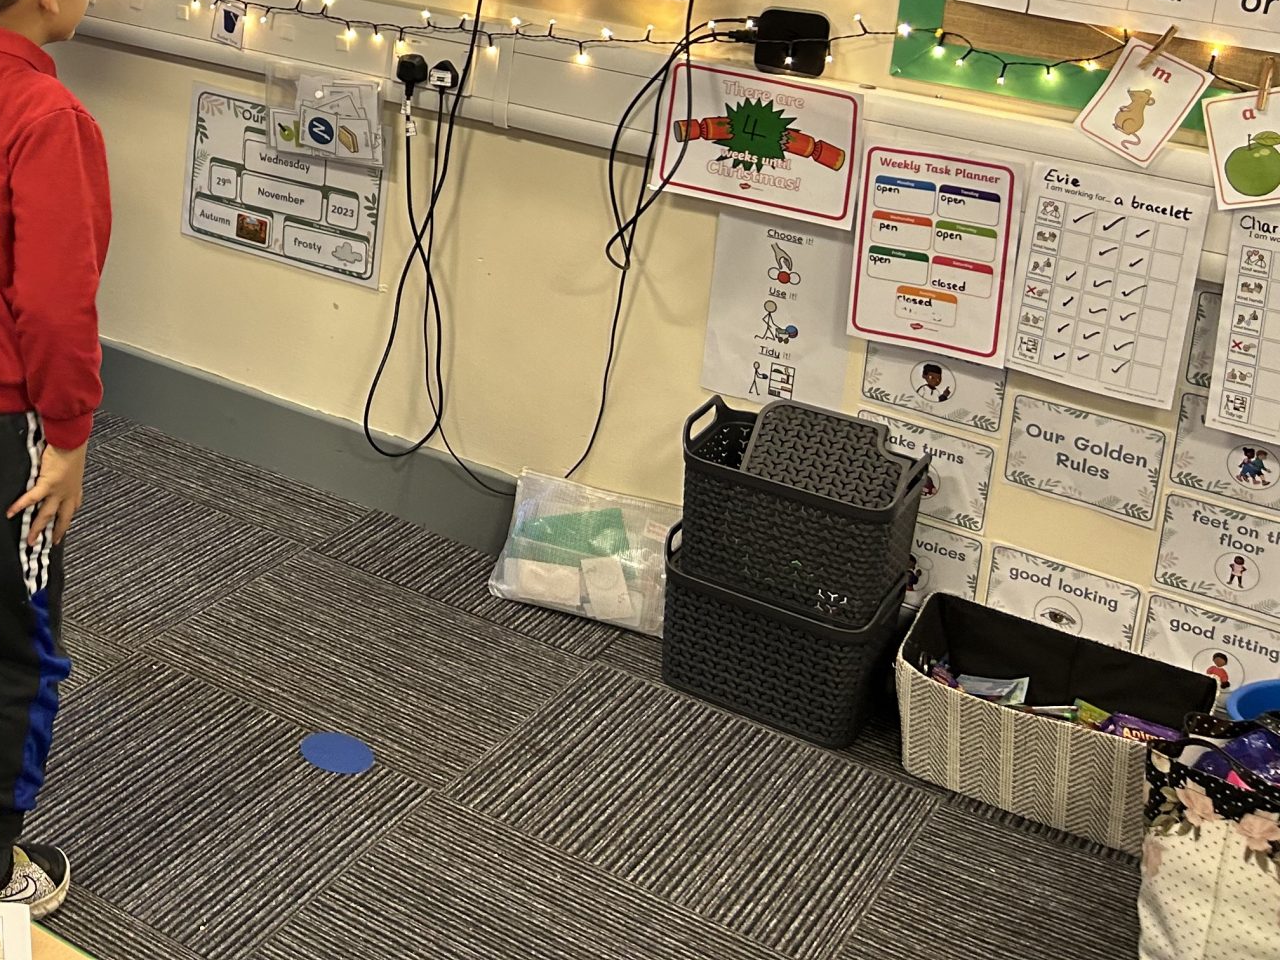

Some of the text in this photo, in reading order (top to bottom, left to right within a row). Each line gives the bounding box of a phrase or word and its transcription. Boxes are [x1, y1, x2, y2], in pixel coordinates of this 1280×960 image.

[1152, 66, 1172, 84] m
[723, 80, 805, 110] There are
[242, 109, 267, 126] Our
[1242, 107, 1257, 121] a
[742, 114, 767, 142] 4
[259, 151, 311, 175] Wednesday
[721, 148, 792, 171] weeks until
[706, 160, 802, 192] Christmas!
[880, 156, 1001, 185] Weekly Task Planner
[1044, 168, 1081, 188] Evie
[216, 175, 232, 187] 29th
[876, 185, 900, 195] open
[257, 186, 305, 207] November
[940, 194, 966, 206] open
[1045, 182, 1093, 201] I am working
[330, 204, 355, 219] 2023
[1114, 195, 1193, 221] a bracelet
[199, 209, 231, 228] Autumn
[879, 222, 898, 232] pen
[1240, 215, 1279, 234] Char
[293, 236, 323, 254] frosty
[767, 228, 814, 246] Choose it!
[936, 230, 963, 241] open
[1249, 230, 1268, 241] I am
[869, 254, 891, 266] open
[769, 286, 798, 301] Use it!
[931, 278, 966, 292] closed
[759, 345, 791, 360] Tidy it!
[887, 434, 964, 465] ake turns
[1025, 422, 1149, 469] Our Golden
[1055, 452, 1110, 481] Rules
[1192, 510, 1260, 538] feet on
[916, 538, 967, 562] voices
[1219, 532, 1266, 557] floor
[1009, 566, 1119, 612] good looking
[1169, 615, 1280, 663] good sitting
